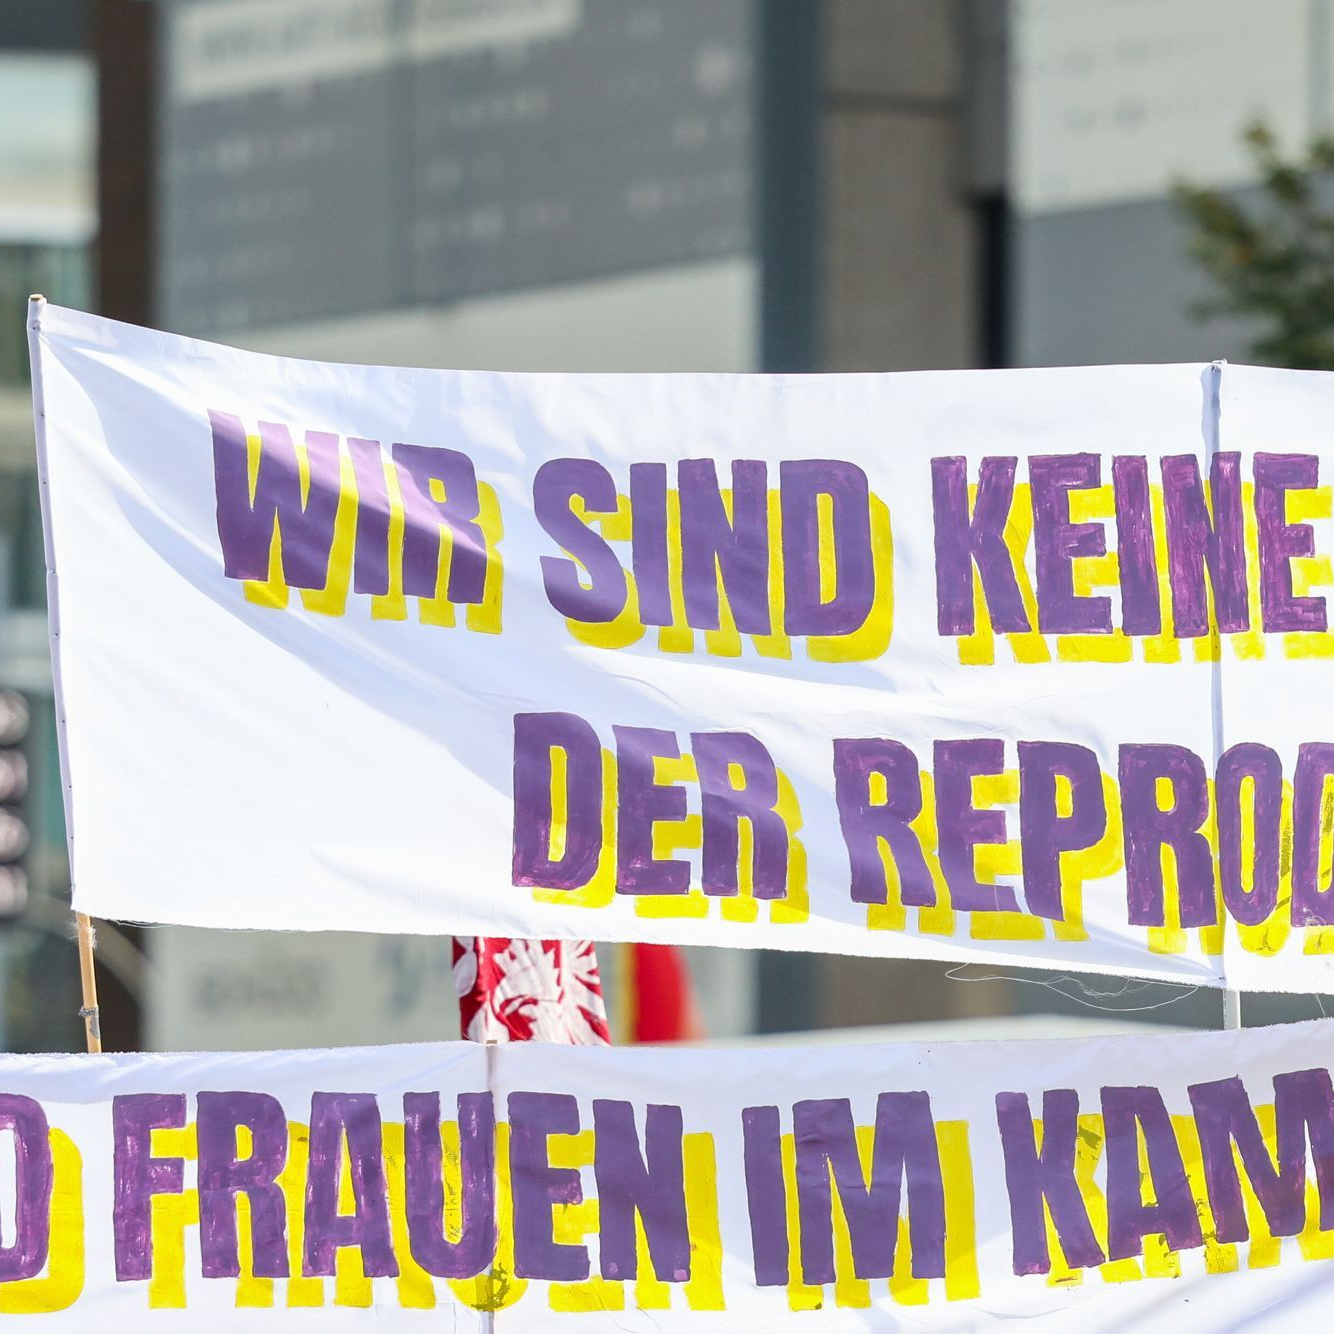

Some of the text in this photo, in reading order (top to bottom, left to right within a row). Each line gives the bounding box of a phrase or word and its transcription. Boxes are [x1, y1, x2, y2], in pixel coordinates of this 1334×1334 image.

[208, 409, 503, 634] WIR
[533, 458, 893, 664] SIND
[512, 711, 809, 924] DER
[113, 1091, 725, 1313] FRAUEN
[742, 1091, 981, 1312] IM
